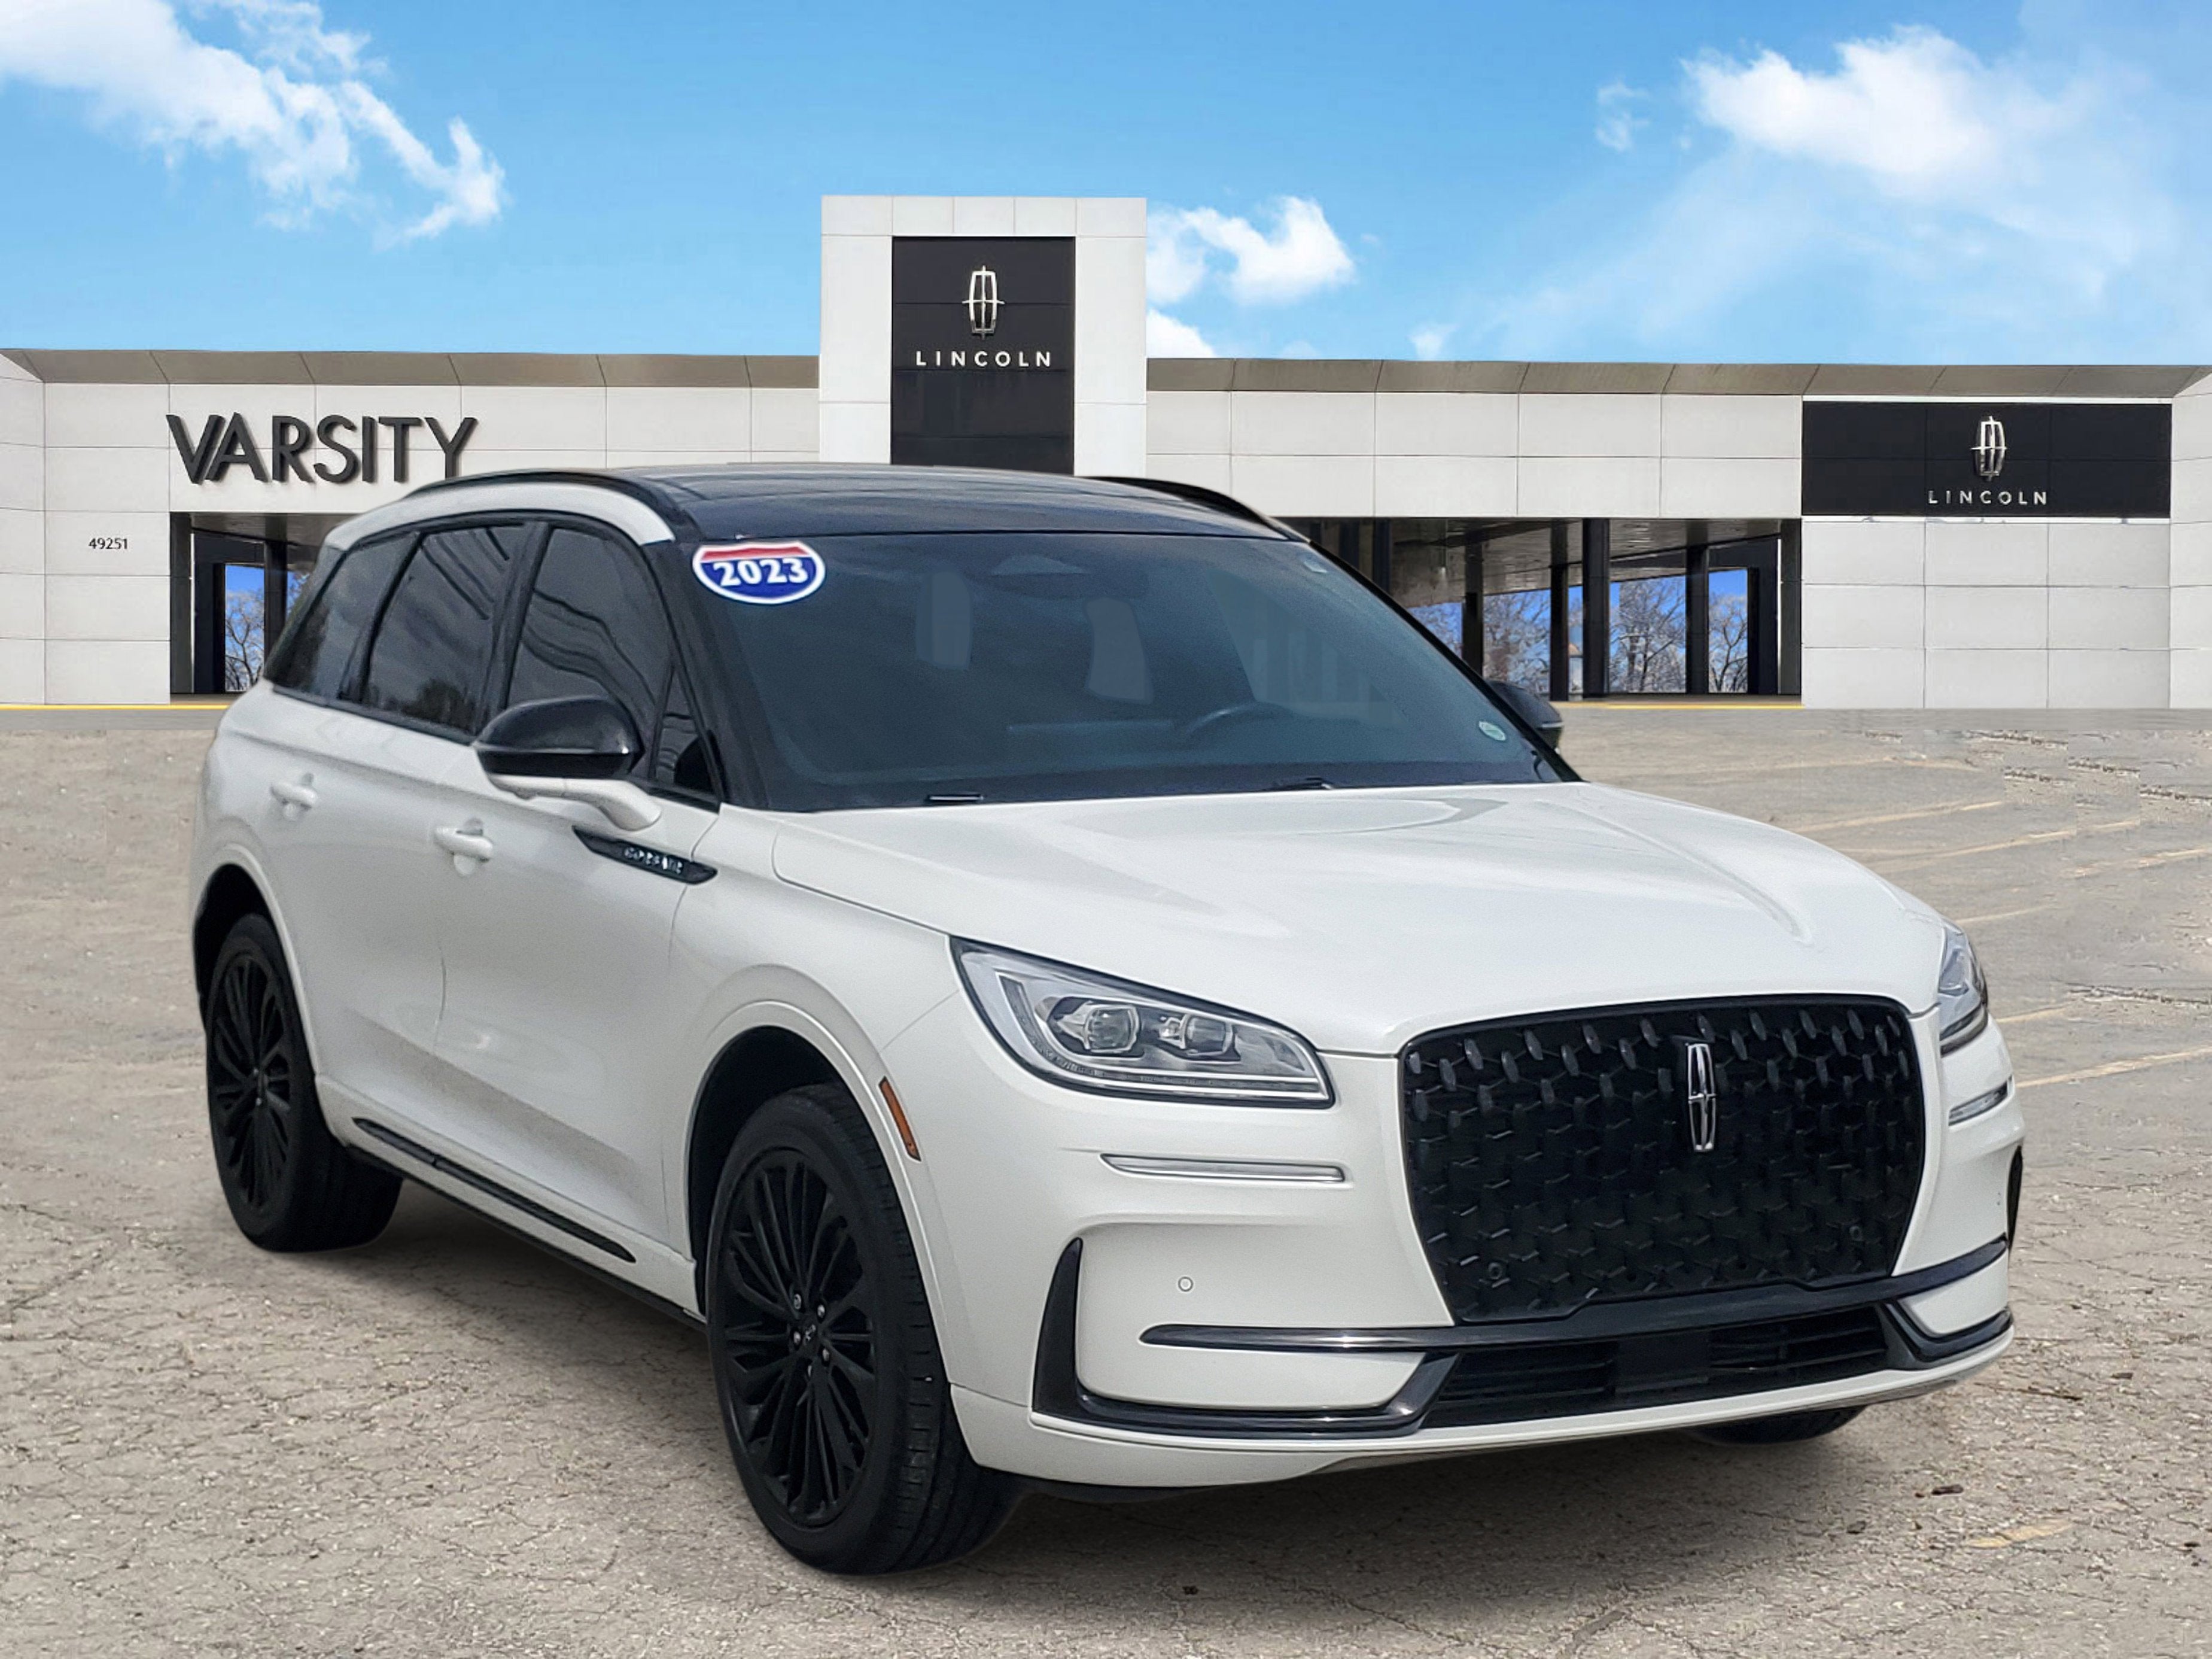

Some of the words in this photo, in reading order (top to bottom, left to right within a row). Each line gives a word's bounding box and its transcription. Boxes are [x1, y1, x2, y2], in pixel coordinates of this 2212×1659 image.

[915, 351, 1052, 367] LINCOLN
[166, 412, 479, 484] VARSITY
[1928, 490, 2047, 506] LINCOLN
[88, 537, 128, 550] 49251
[713, 558, 809, 587] 2023
